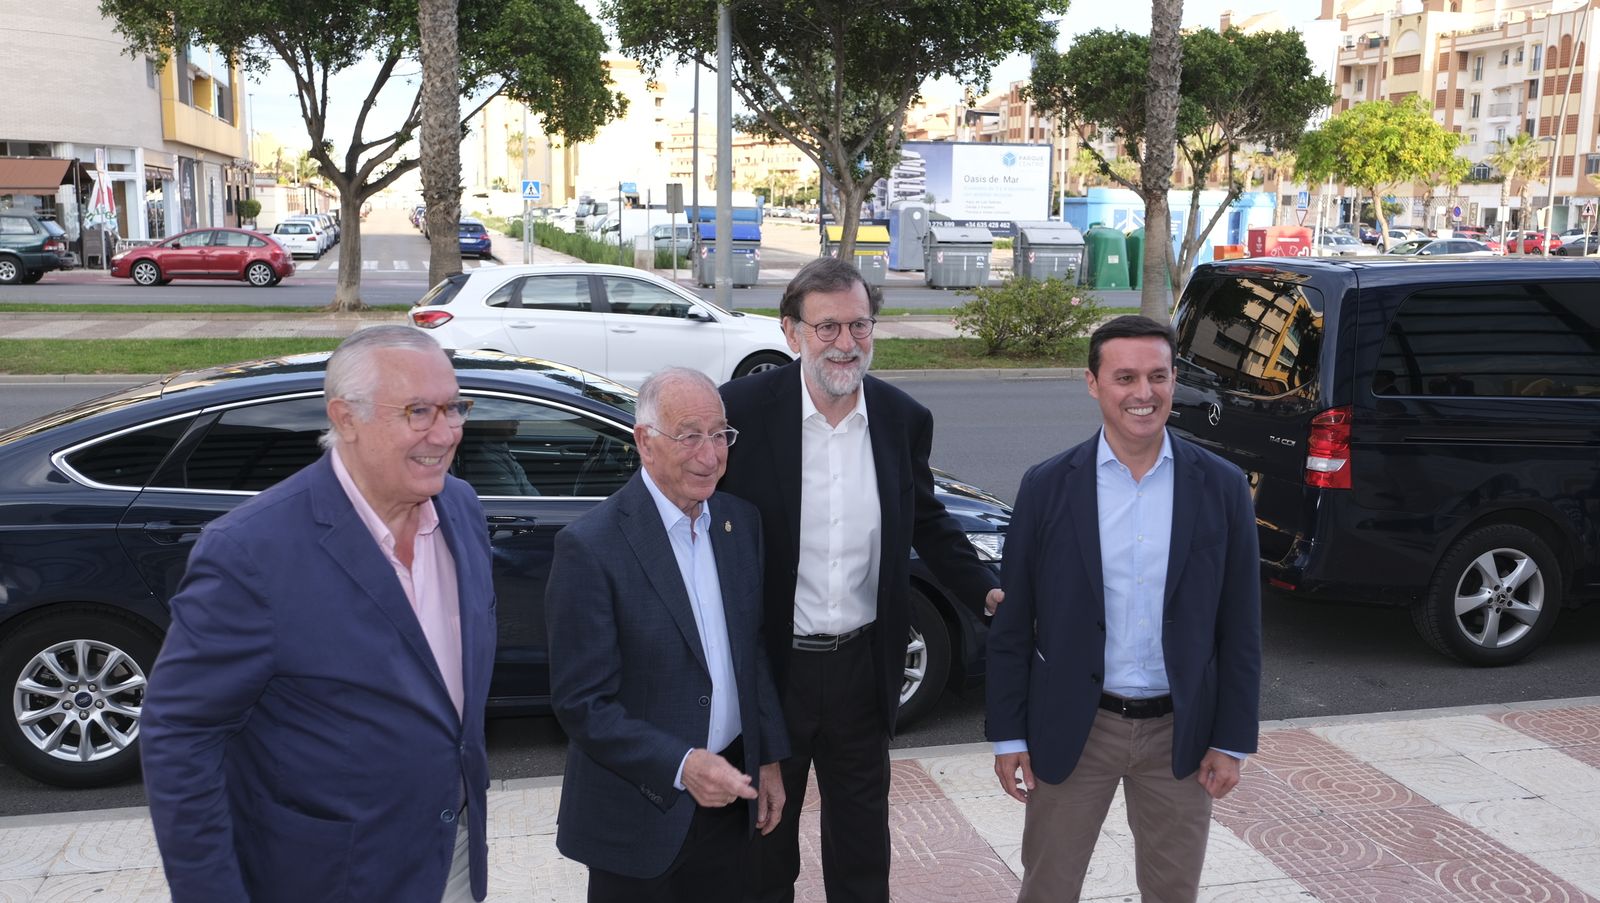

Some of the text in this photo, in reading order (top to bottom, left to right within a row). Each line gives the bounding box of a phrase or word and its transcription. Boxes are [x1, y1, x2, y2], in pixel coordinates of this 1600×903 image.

[963, 174, 1019, 183] Oasis de Mar
[1281, 438, 1297, 447] CDI
